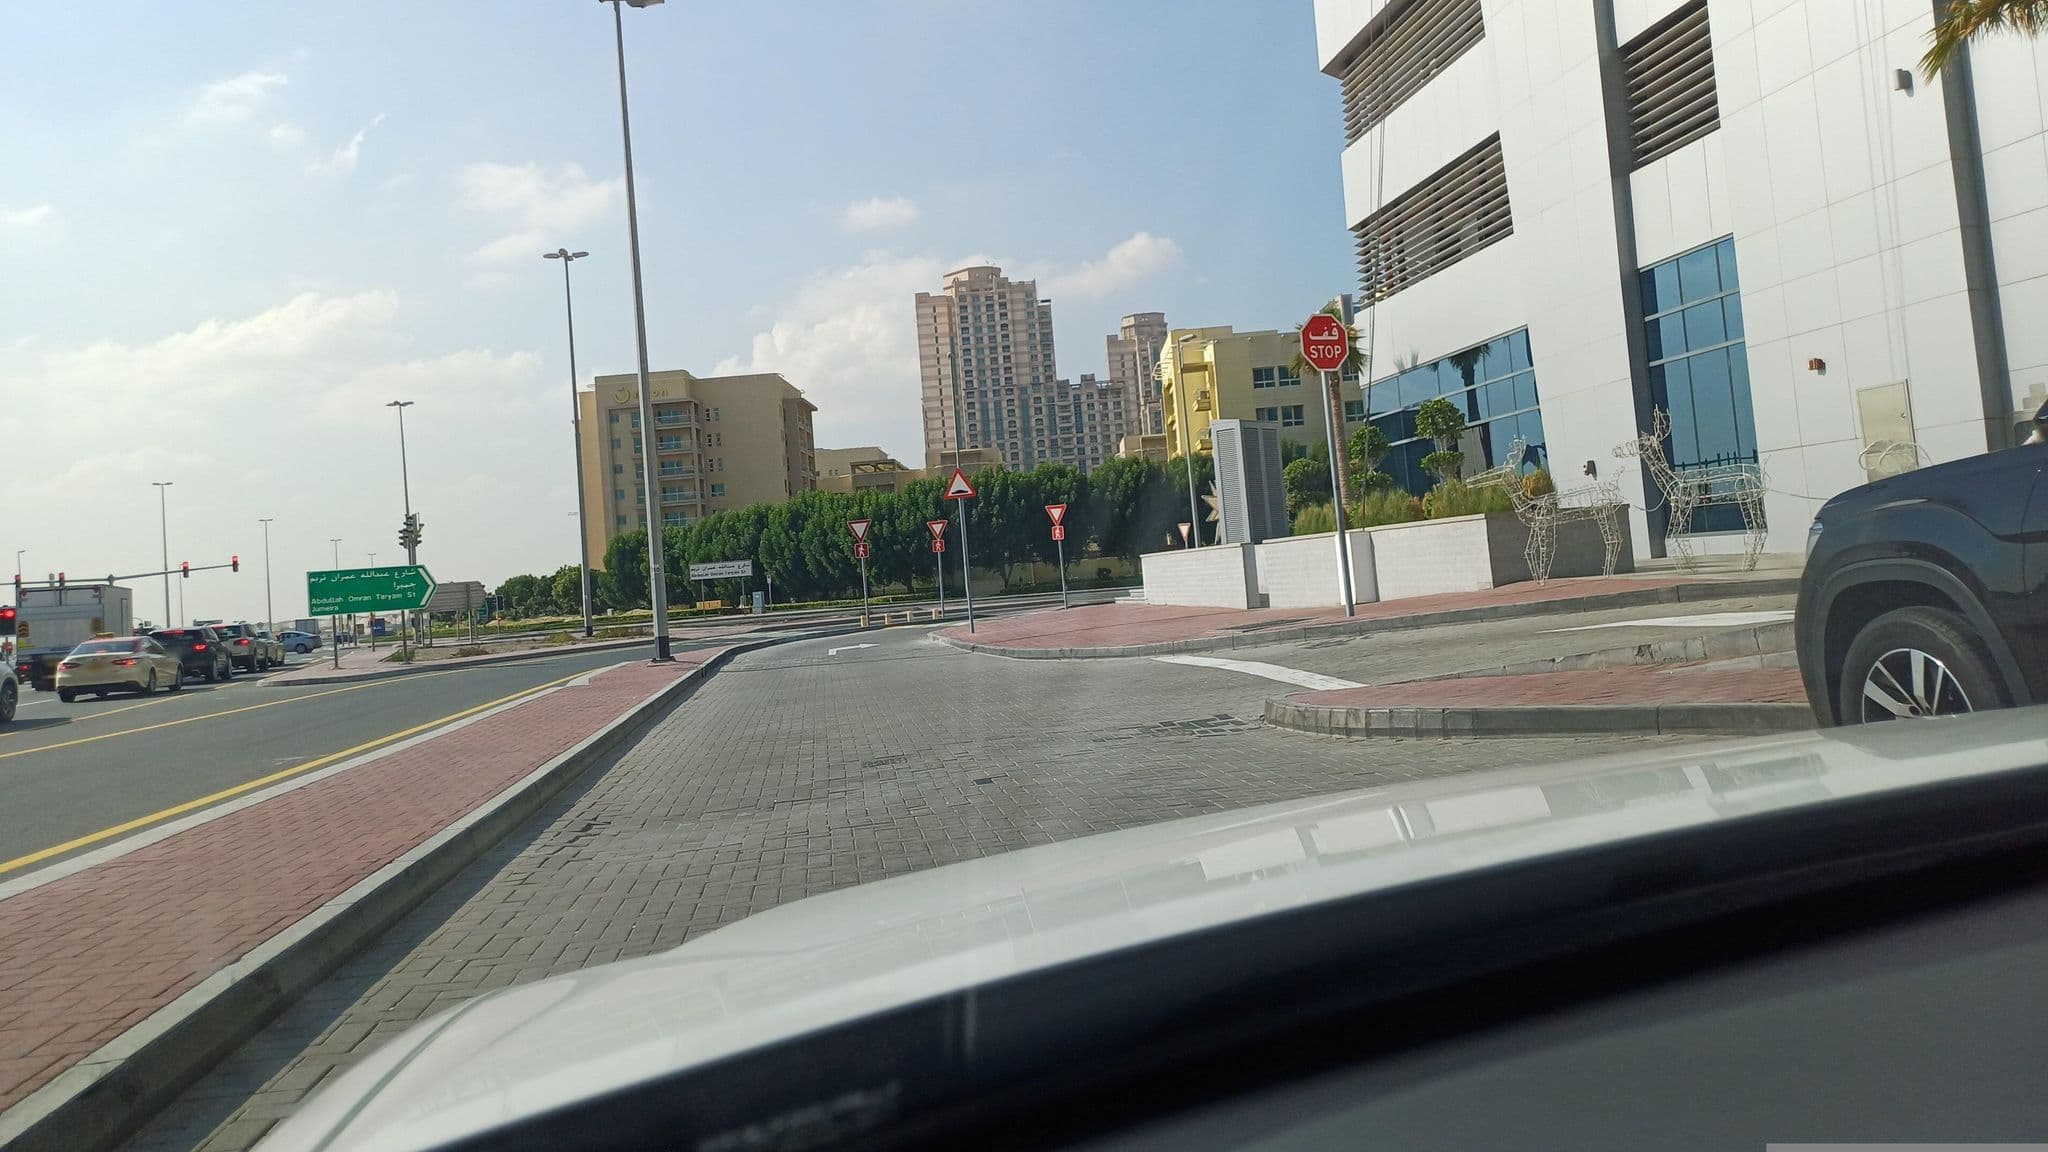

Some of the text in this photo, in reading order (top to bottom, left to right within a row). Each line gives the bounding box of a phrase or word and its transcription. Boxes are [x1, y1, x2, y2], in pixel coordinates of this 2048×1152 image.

[1309, 322, 1339, 340] قف
[1310, 345, 1341, 359] STOP
[310, 569, 416, 583] شارع عبدالله عمران تريم
[393, 581, 417, 591] جميرا
[311, 596, 344, 605] Abdullah
[375, 593, 402, 601] Taryam
[312, 605, 339, 613] Jumeira
